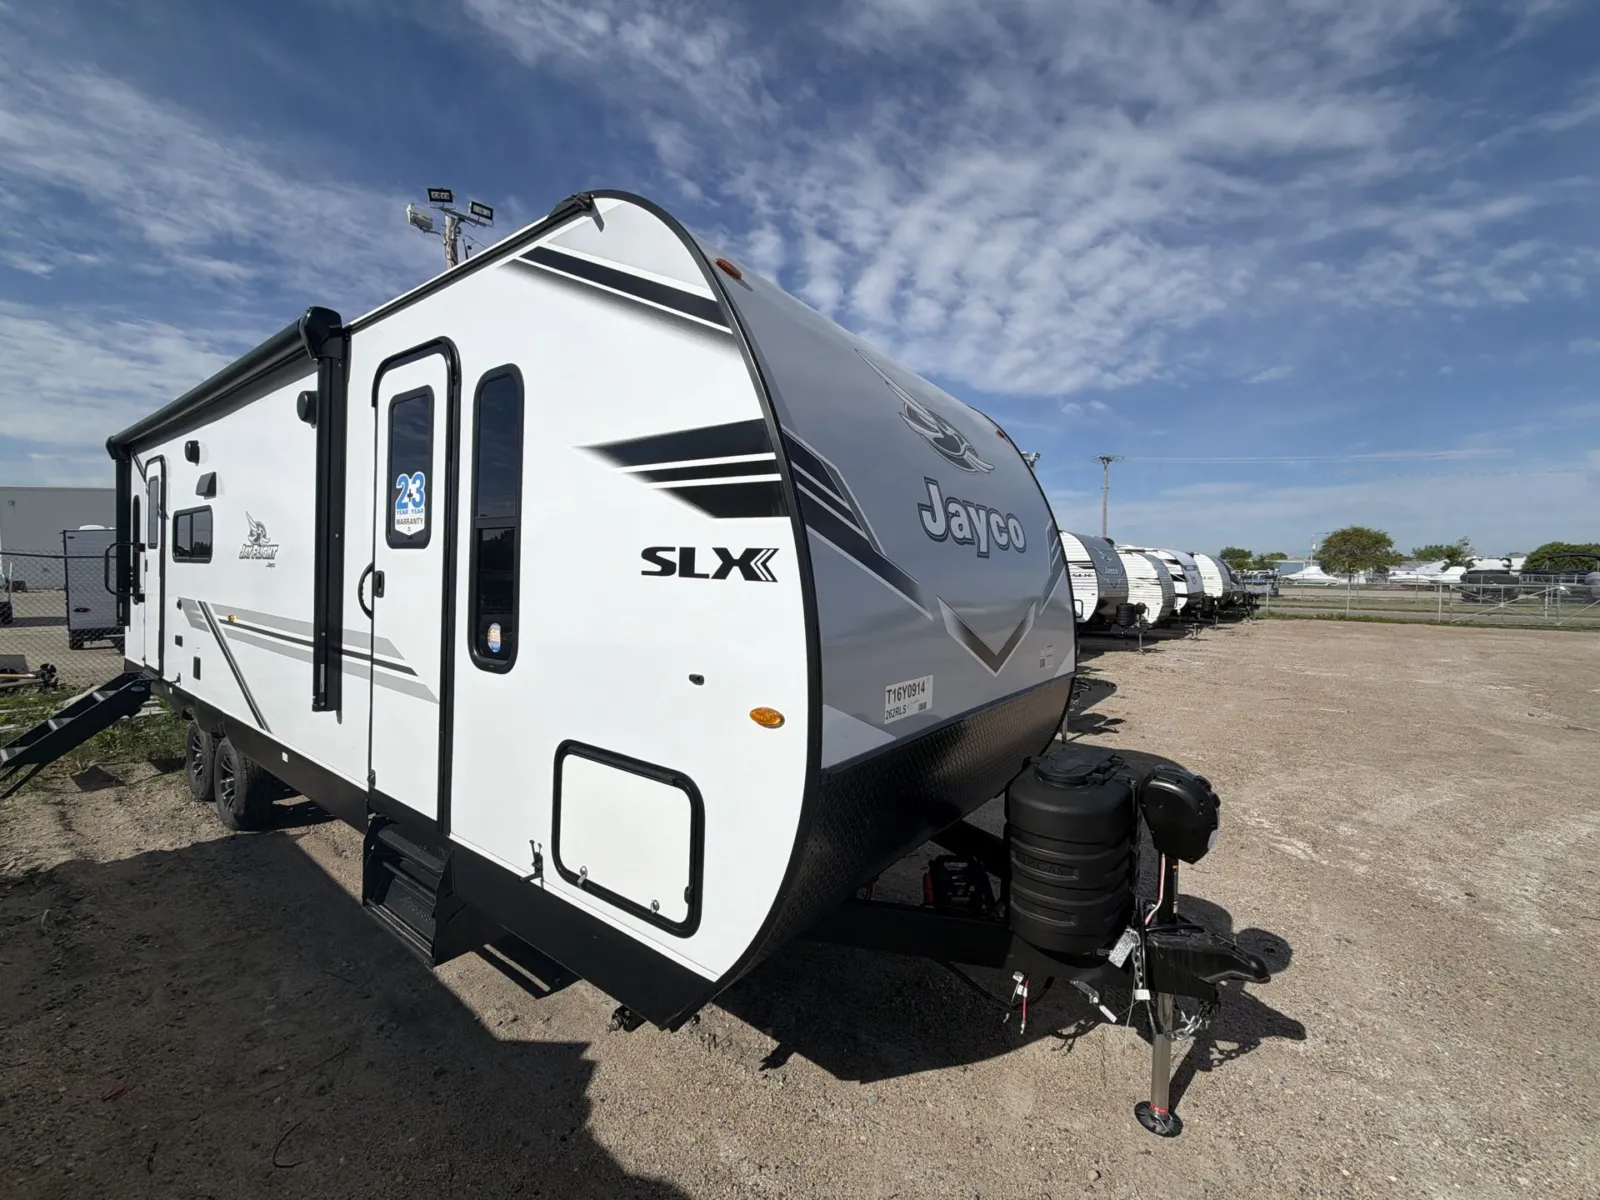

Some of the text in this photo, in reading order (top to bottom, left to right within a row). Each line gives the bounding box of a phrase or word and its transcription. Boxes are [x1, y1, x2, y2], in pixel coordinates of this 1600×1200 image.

[396, 517, 424, 525] WARRANTY
[917, 476, 1027, 559] Jayco
[640, 546, 780, 583] SLX
[886, 680, 926, 705] T16Y0914
